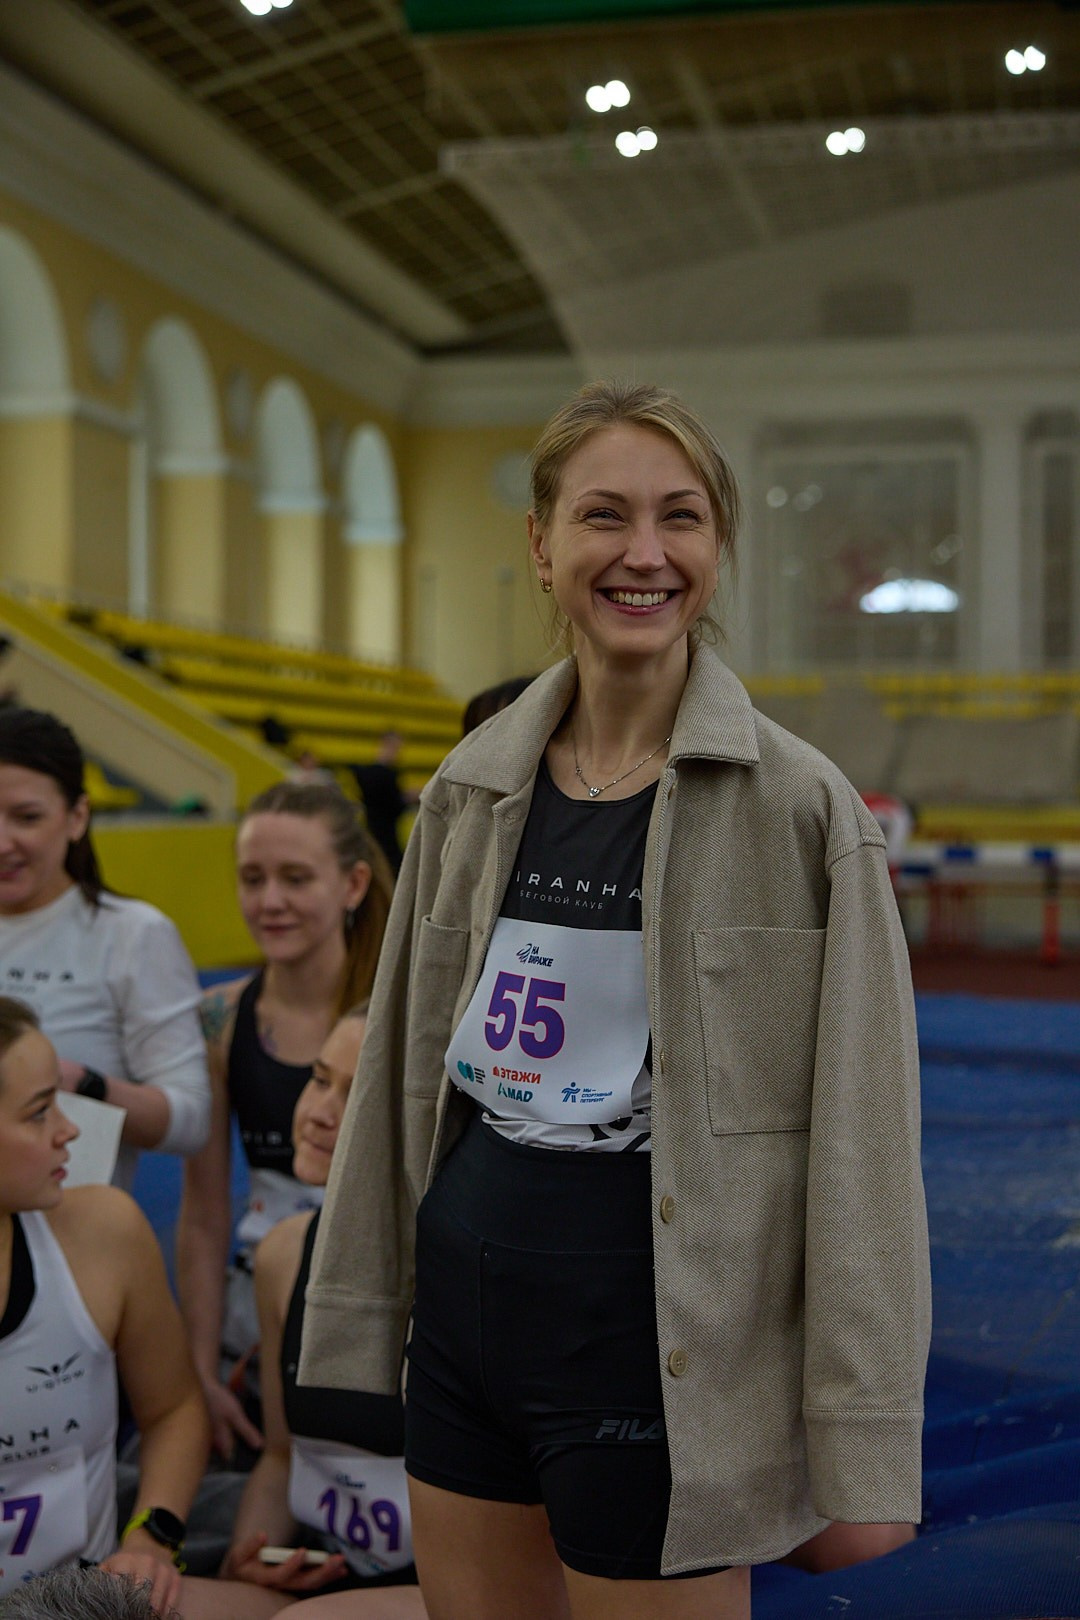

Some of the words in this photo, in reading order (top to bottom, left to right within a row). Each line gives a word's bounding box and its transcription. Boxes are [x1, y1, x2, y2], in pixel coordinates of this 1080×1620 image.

[520, 889, 570, 905] БЕГОВОЙ
[575, 899, 604, 910] КЛУБ
[484, 970, 566, 1059] 55
[500, 1067, 541, 1084] этажи
[595, 1418, 664, 1440] FILA
[317, 1486, 402, 1553] 169
